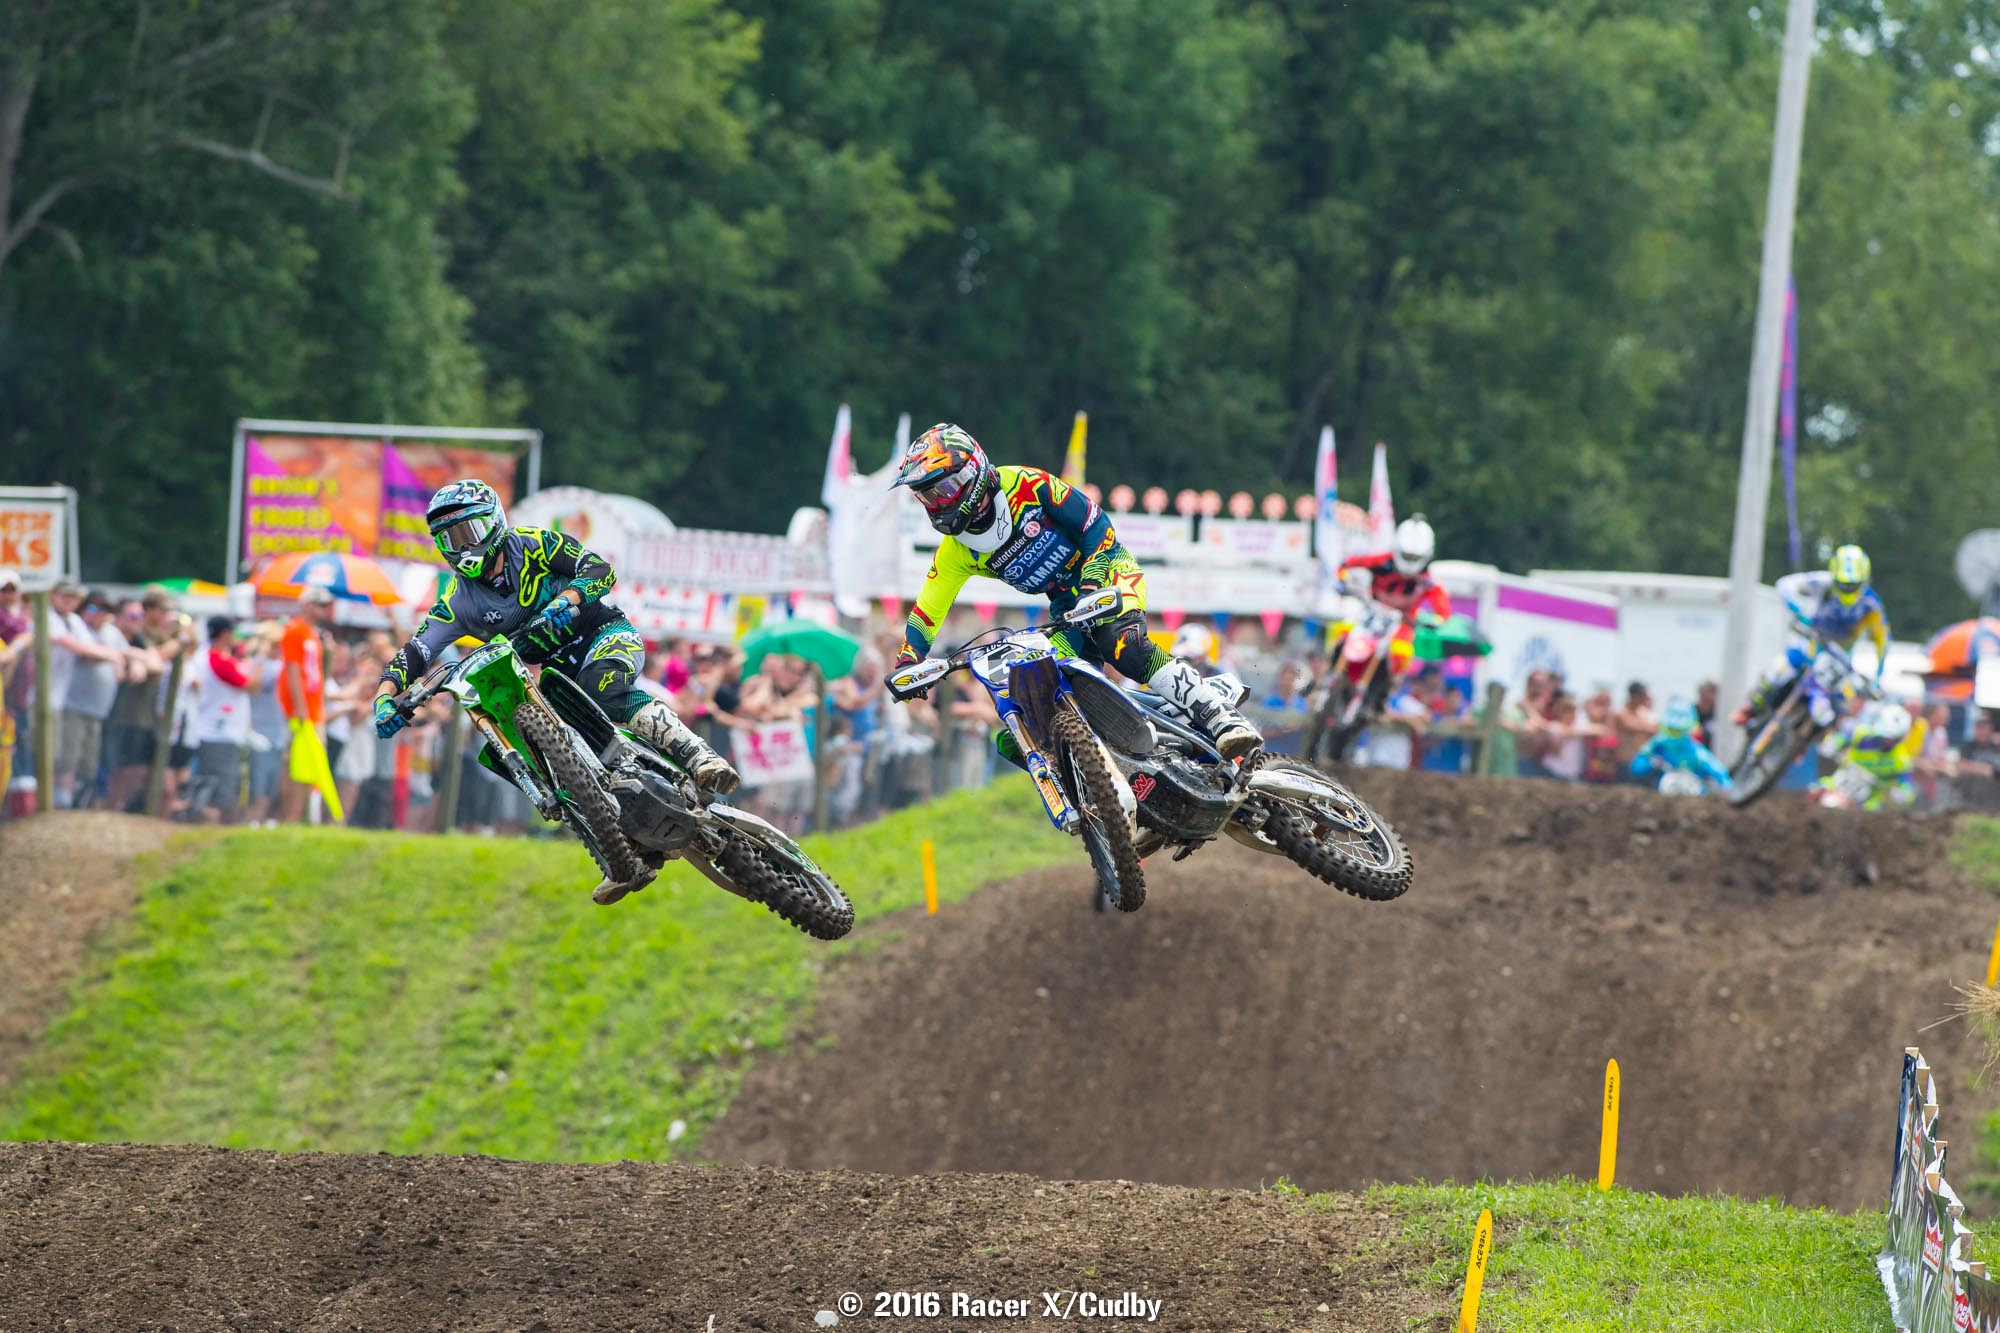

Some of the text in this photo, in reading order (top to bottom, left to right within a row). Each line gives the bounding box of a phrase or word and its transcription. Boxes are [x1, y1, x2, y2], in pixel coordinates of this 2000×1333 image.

[991, 535, 1028, 570] Autotrader
[1018, 530, 1053, 564] TOYOTA
[1021, 544, 1071, 588] YAMAHA
[1476, 1228, 1487, 1269] ACERBIS
